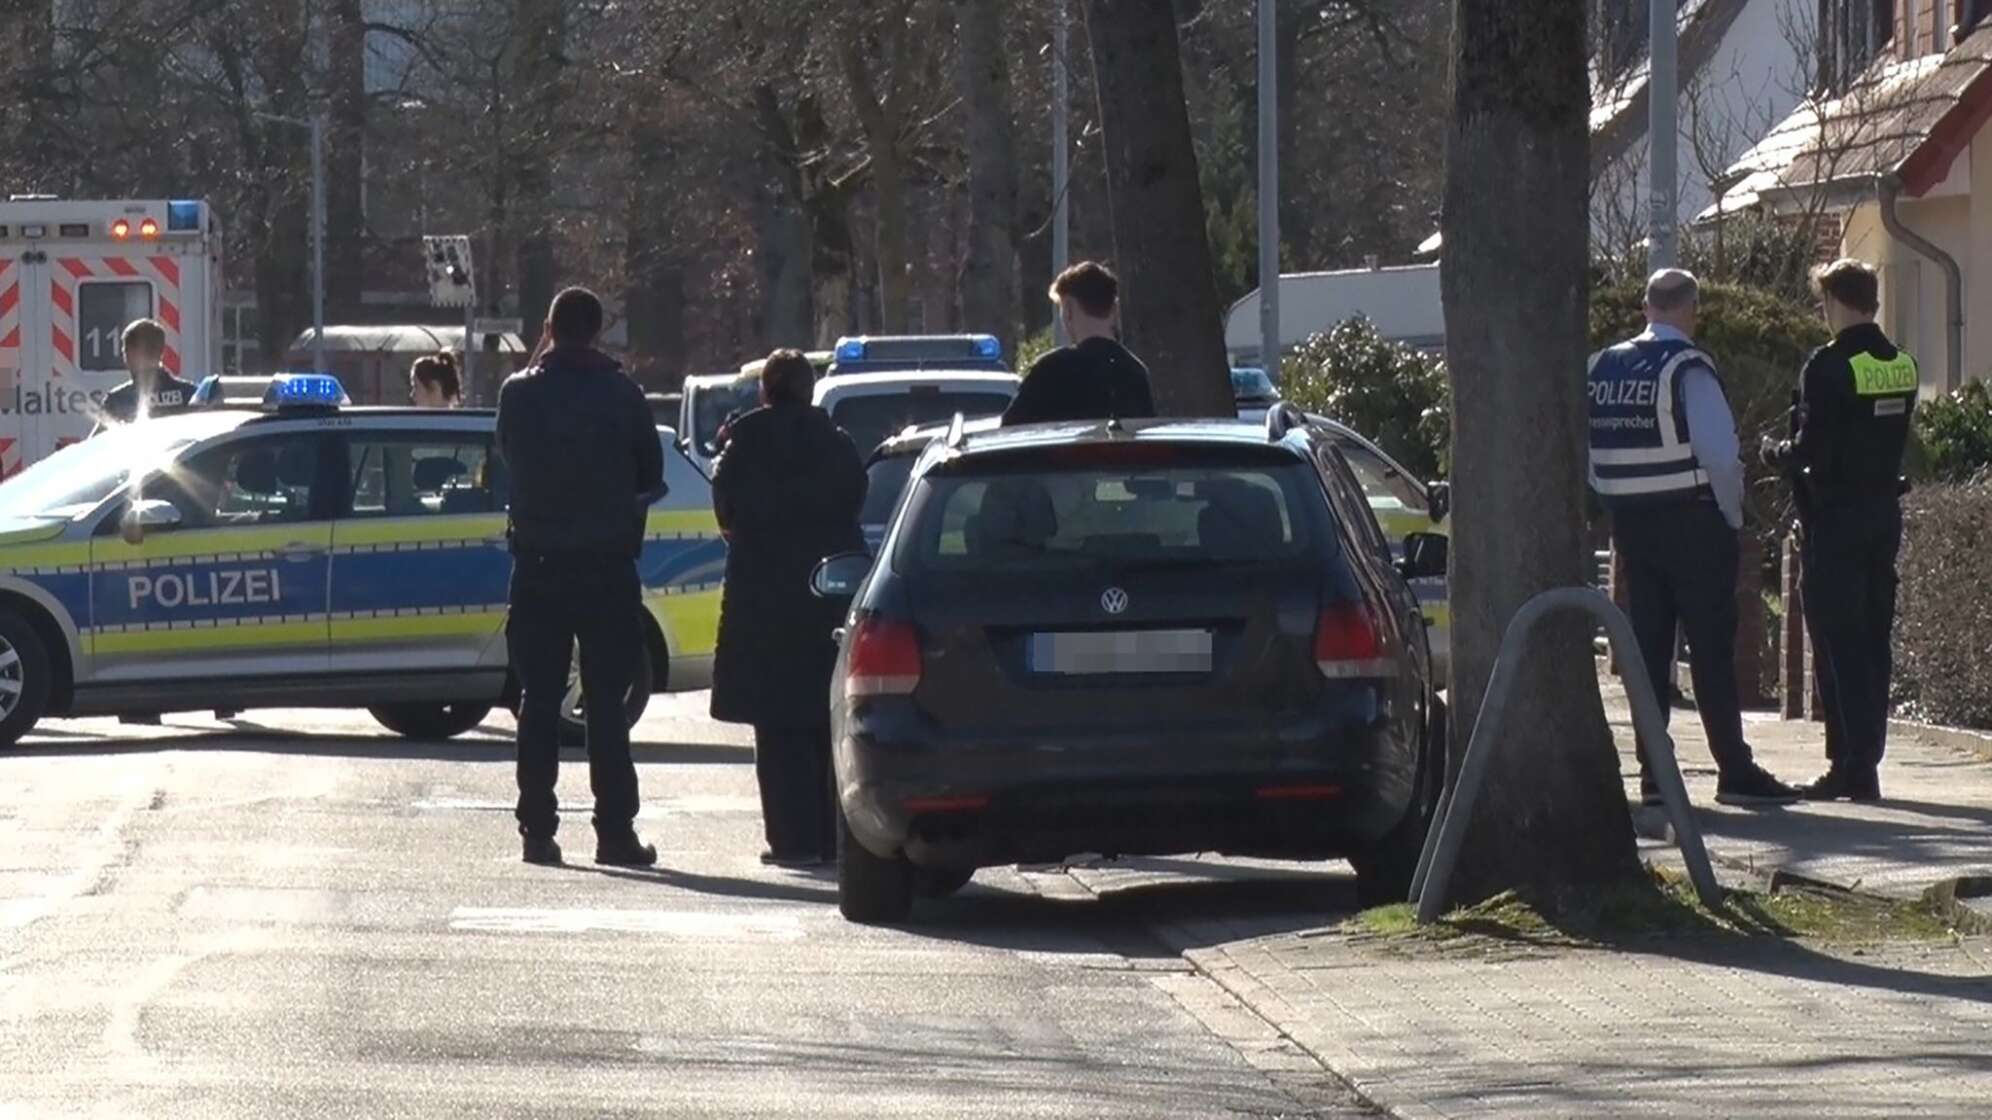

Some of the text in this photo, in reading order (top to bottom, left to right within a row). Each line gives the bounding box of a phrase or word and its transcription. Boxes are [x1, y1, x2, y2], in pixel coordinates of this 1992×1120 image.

[87, 326, 120, 357] 11
[1587, 379, 1657, 405] POLIZEI
[128, 568, 281, 609] POLIZEI
